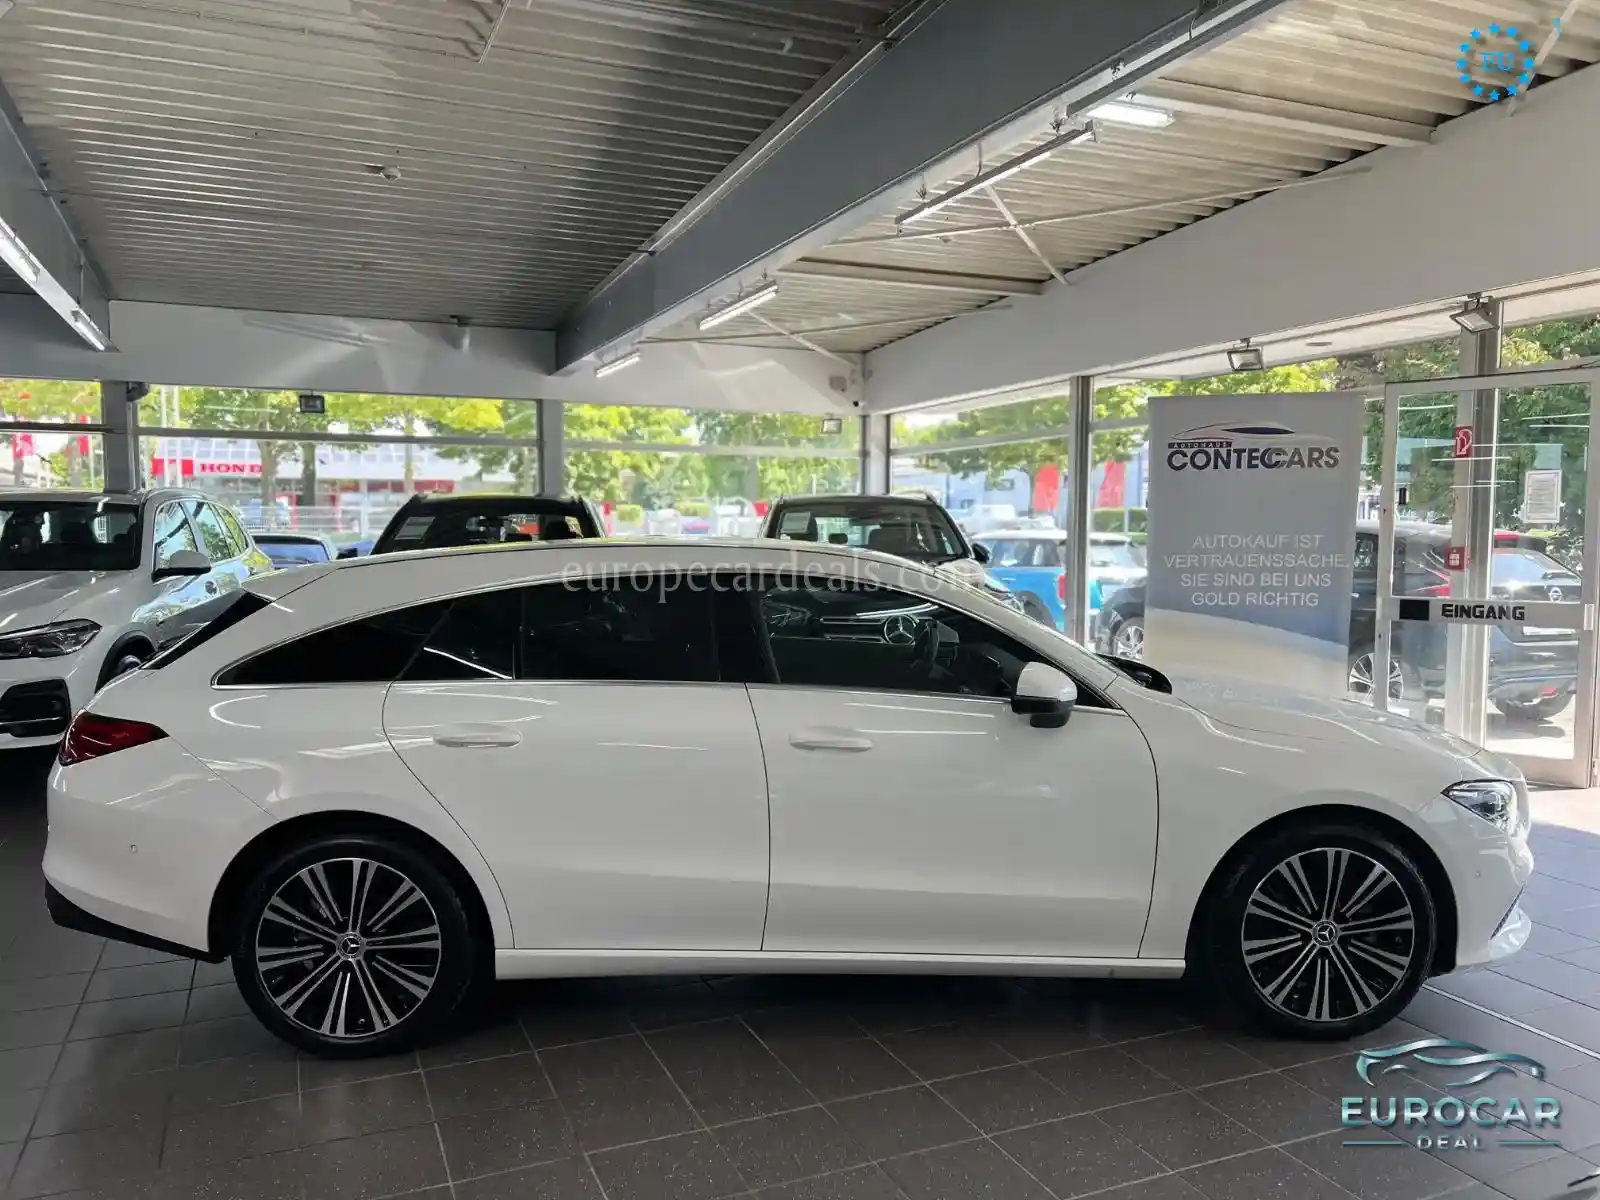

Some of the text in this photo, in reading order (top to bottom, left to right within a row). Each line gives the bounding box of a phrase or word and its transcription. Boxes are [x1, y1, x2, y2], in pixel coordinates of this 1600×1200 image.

[200, 463, 264, 473] HOND
[1192, 534, 1324, 549] AUTOKAUF IST
[1180, 573, 1332, 588] SIE SIND BEI UNS
[1191, 592, 1320, 607] GOLD RICHTIG
[1441, 603, 1526, 621] EINGANG
